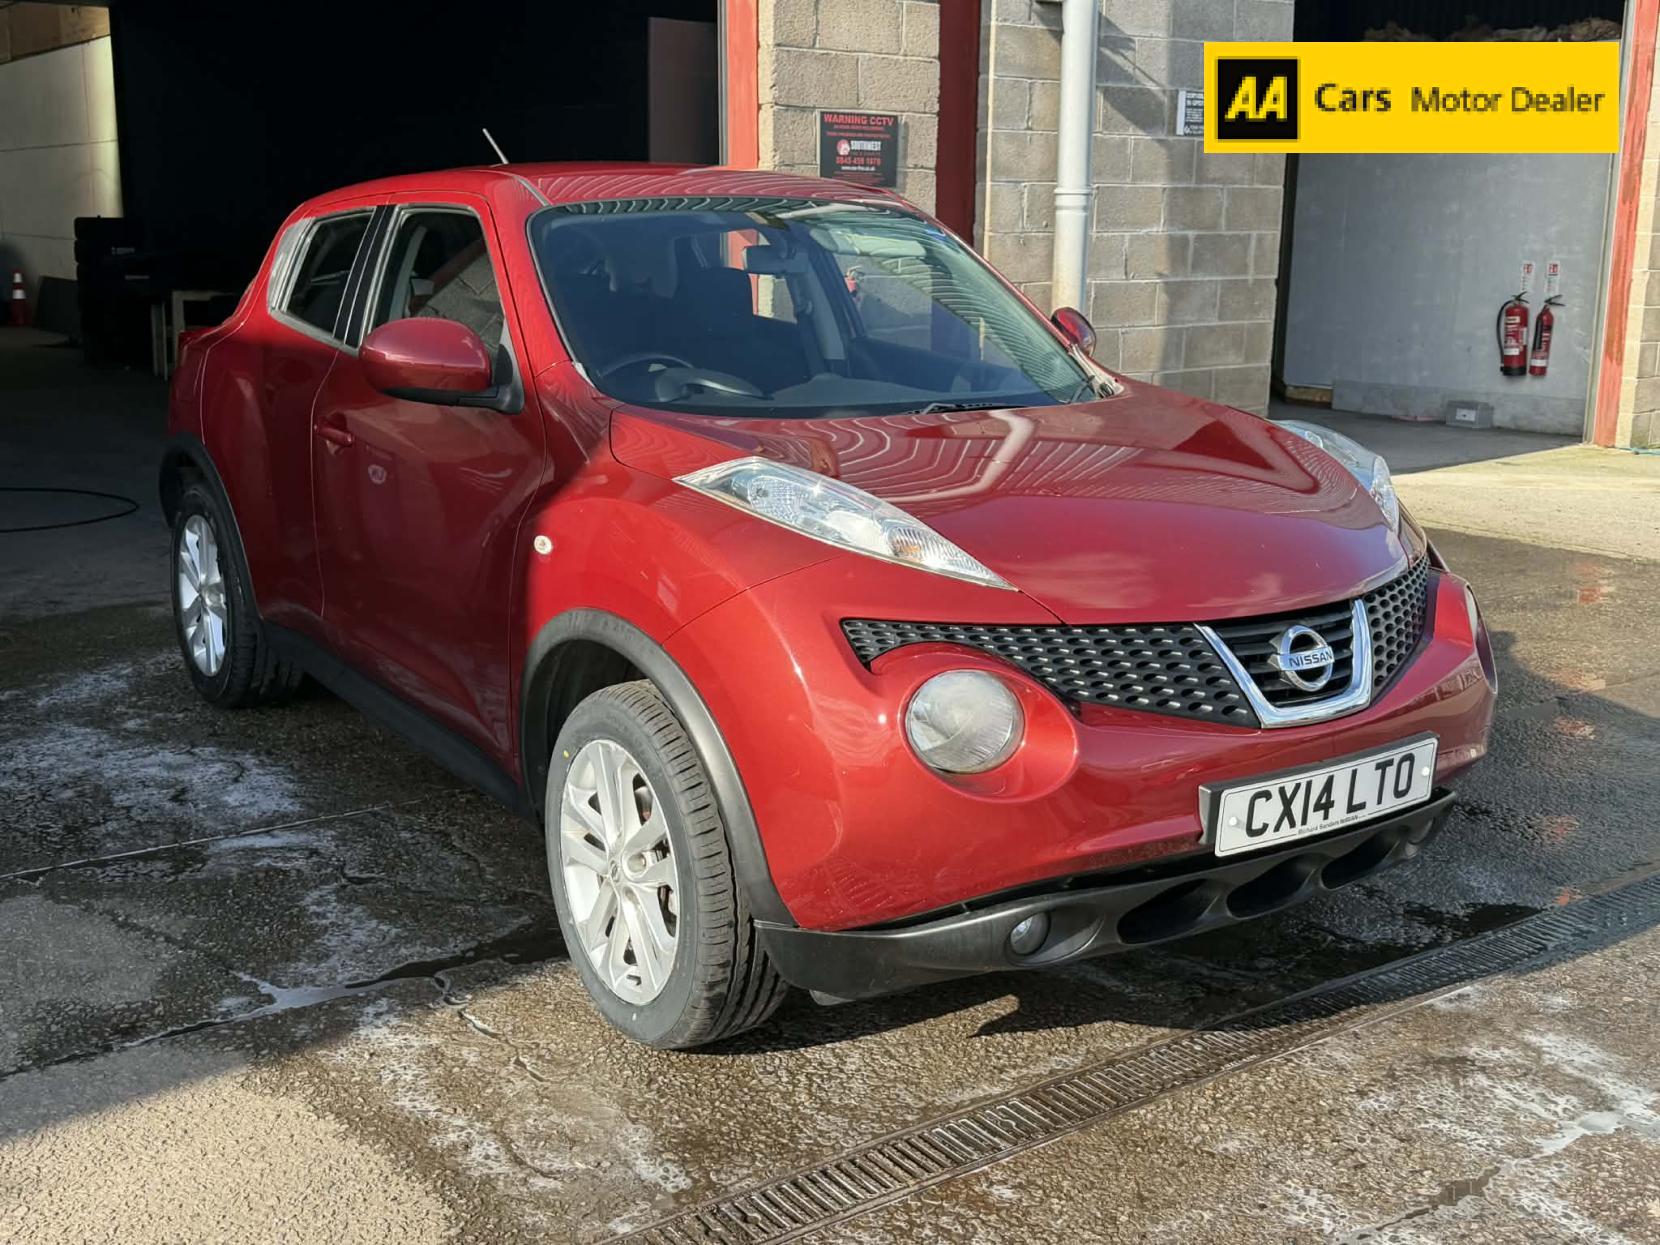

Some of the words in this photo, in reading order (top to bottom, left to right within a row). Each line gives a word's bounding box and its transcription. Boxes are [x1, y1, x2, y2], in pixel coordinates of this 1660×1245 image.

[824, 114, 867, 124] WARNING
[870, 116, 893, 126] CCTV
[1289, 651, 1332, 667] NISSAN
[1246, 774, 1335, 838] CX14
[1346, 752, 1416, 814] LTO
